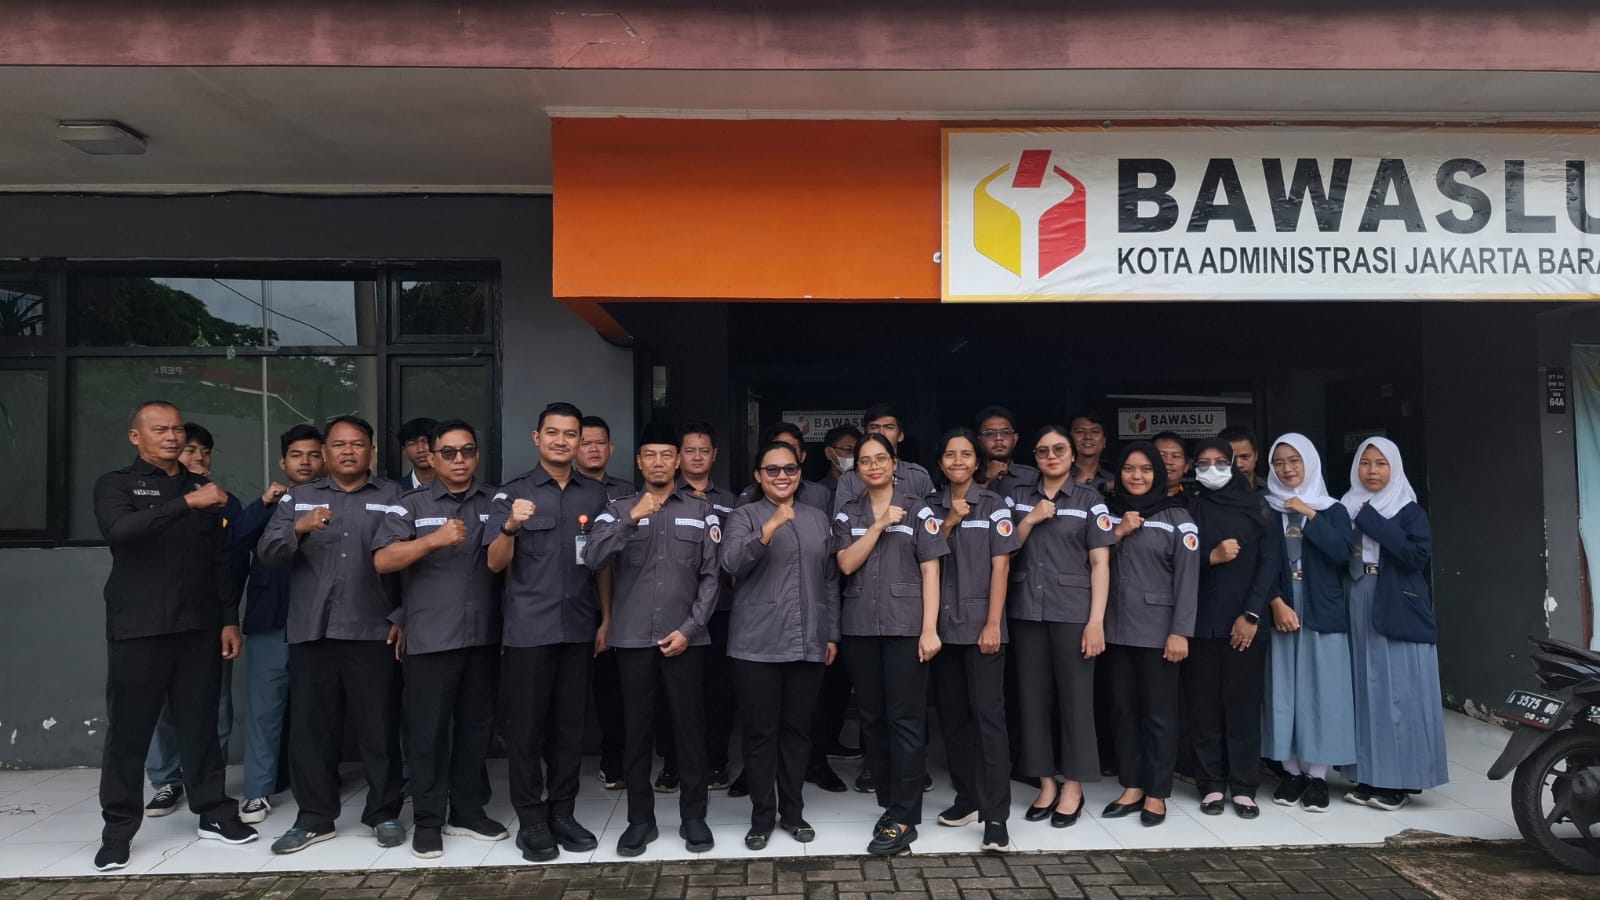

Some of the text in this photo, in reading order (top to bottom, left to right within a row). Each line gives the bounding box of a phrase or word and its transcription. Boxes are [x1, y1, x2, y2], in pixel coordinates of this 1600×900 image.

[1117, 157, 1600, 234] BAWASLU
[1118, 247, 1192, 274] KOTA
[1198, 246, 1396, 274] ADMINISTRASI
[1405, 247, 1531, 274] JAKARTA
[1549, 398, 1564, 406] 64A
[1150, 414, 1214, 425] BAWASLU
[1517, 695, 1542, 710] 3575
